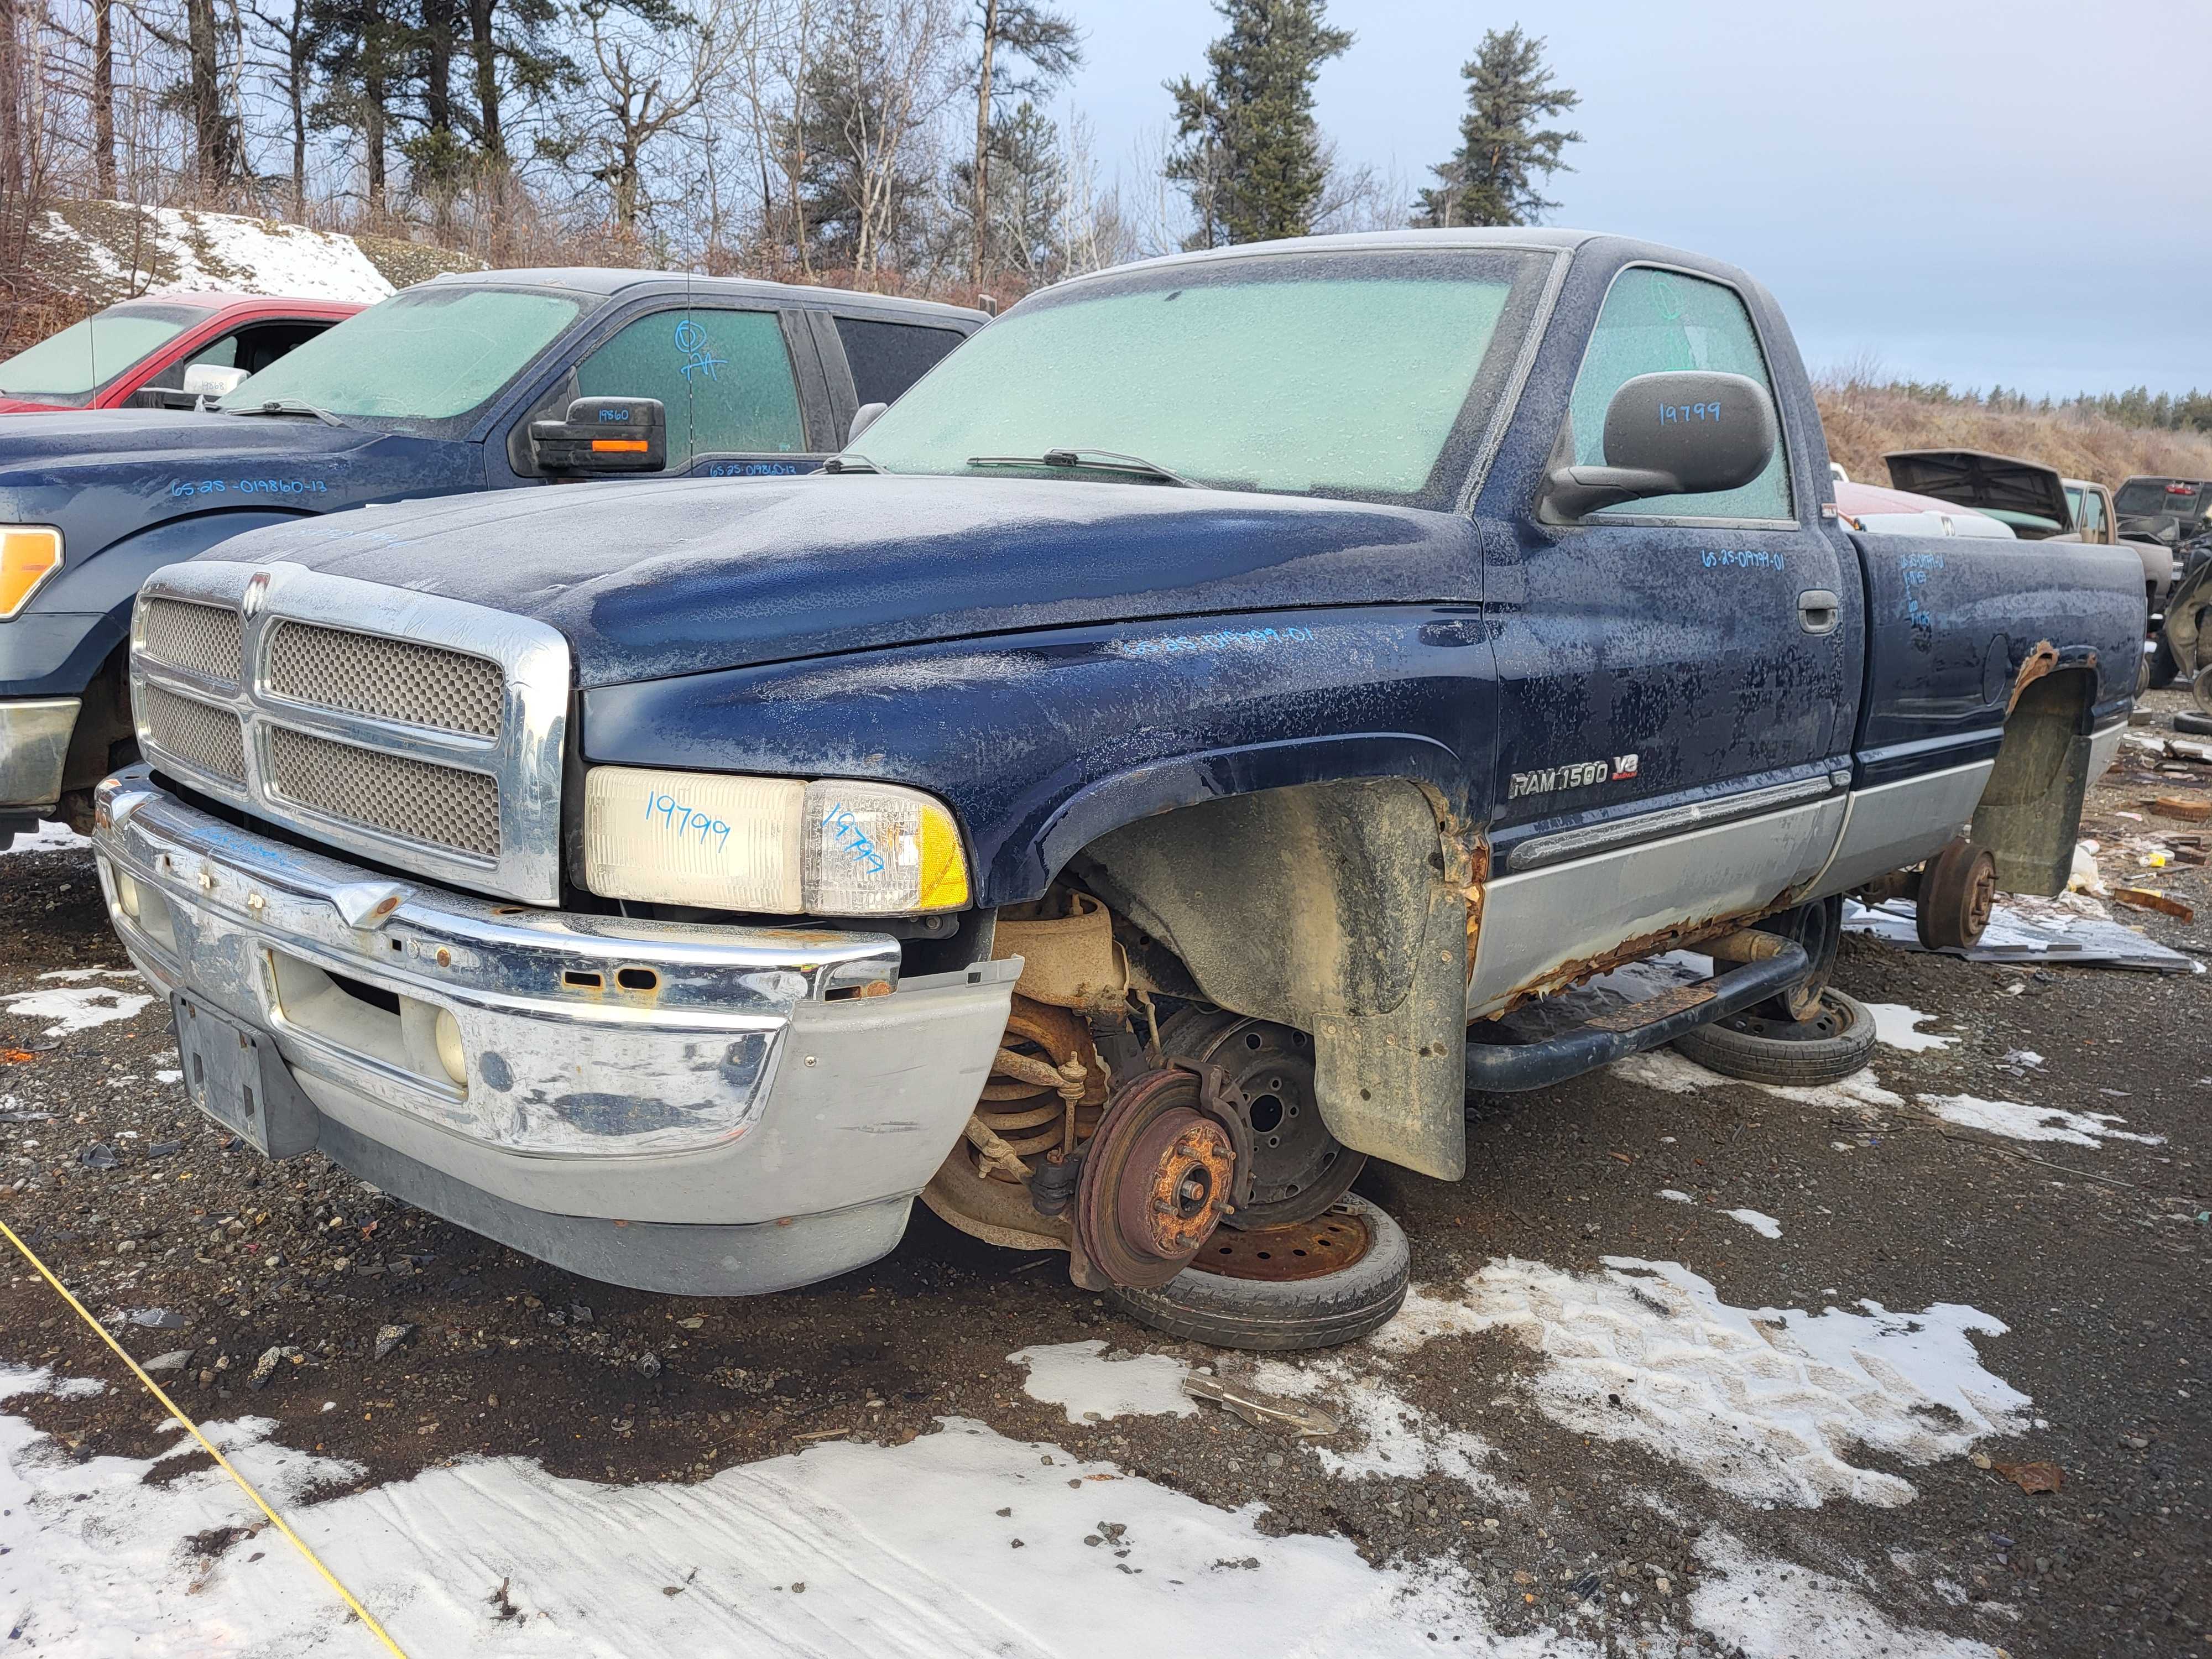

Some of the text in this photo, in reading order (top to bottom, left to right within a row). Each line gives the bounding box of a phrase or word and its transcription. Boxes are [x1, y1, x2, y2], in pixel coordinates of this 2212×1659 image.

[598, 409, 629, 422] 19860
[1660, 402, 1721, 425] 19799
[1508, 754, 1639, 800] RAM 1500 V8
[645, 791, 731, 854] 19799
[822, 803, 885, 874] 19799
